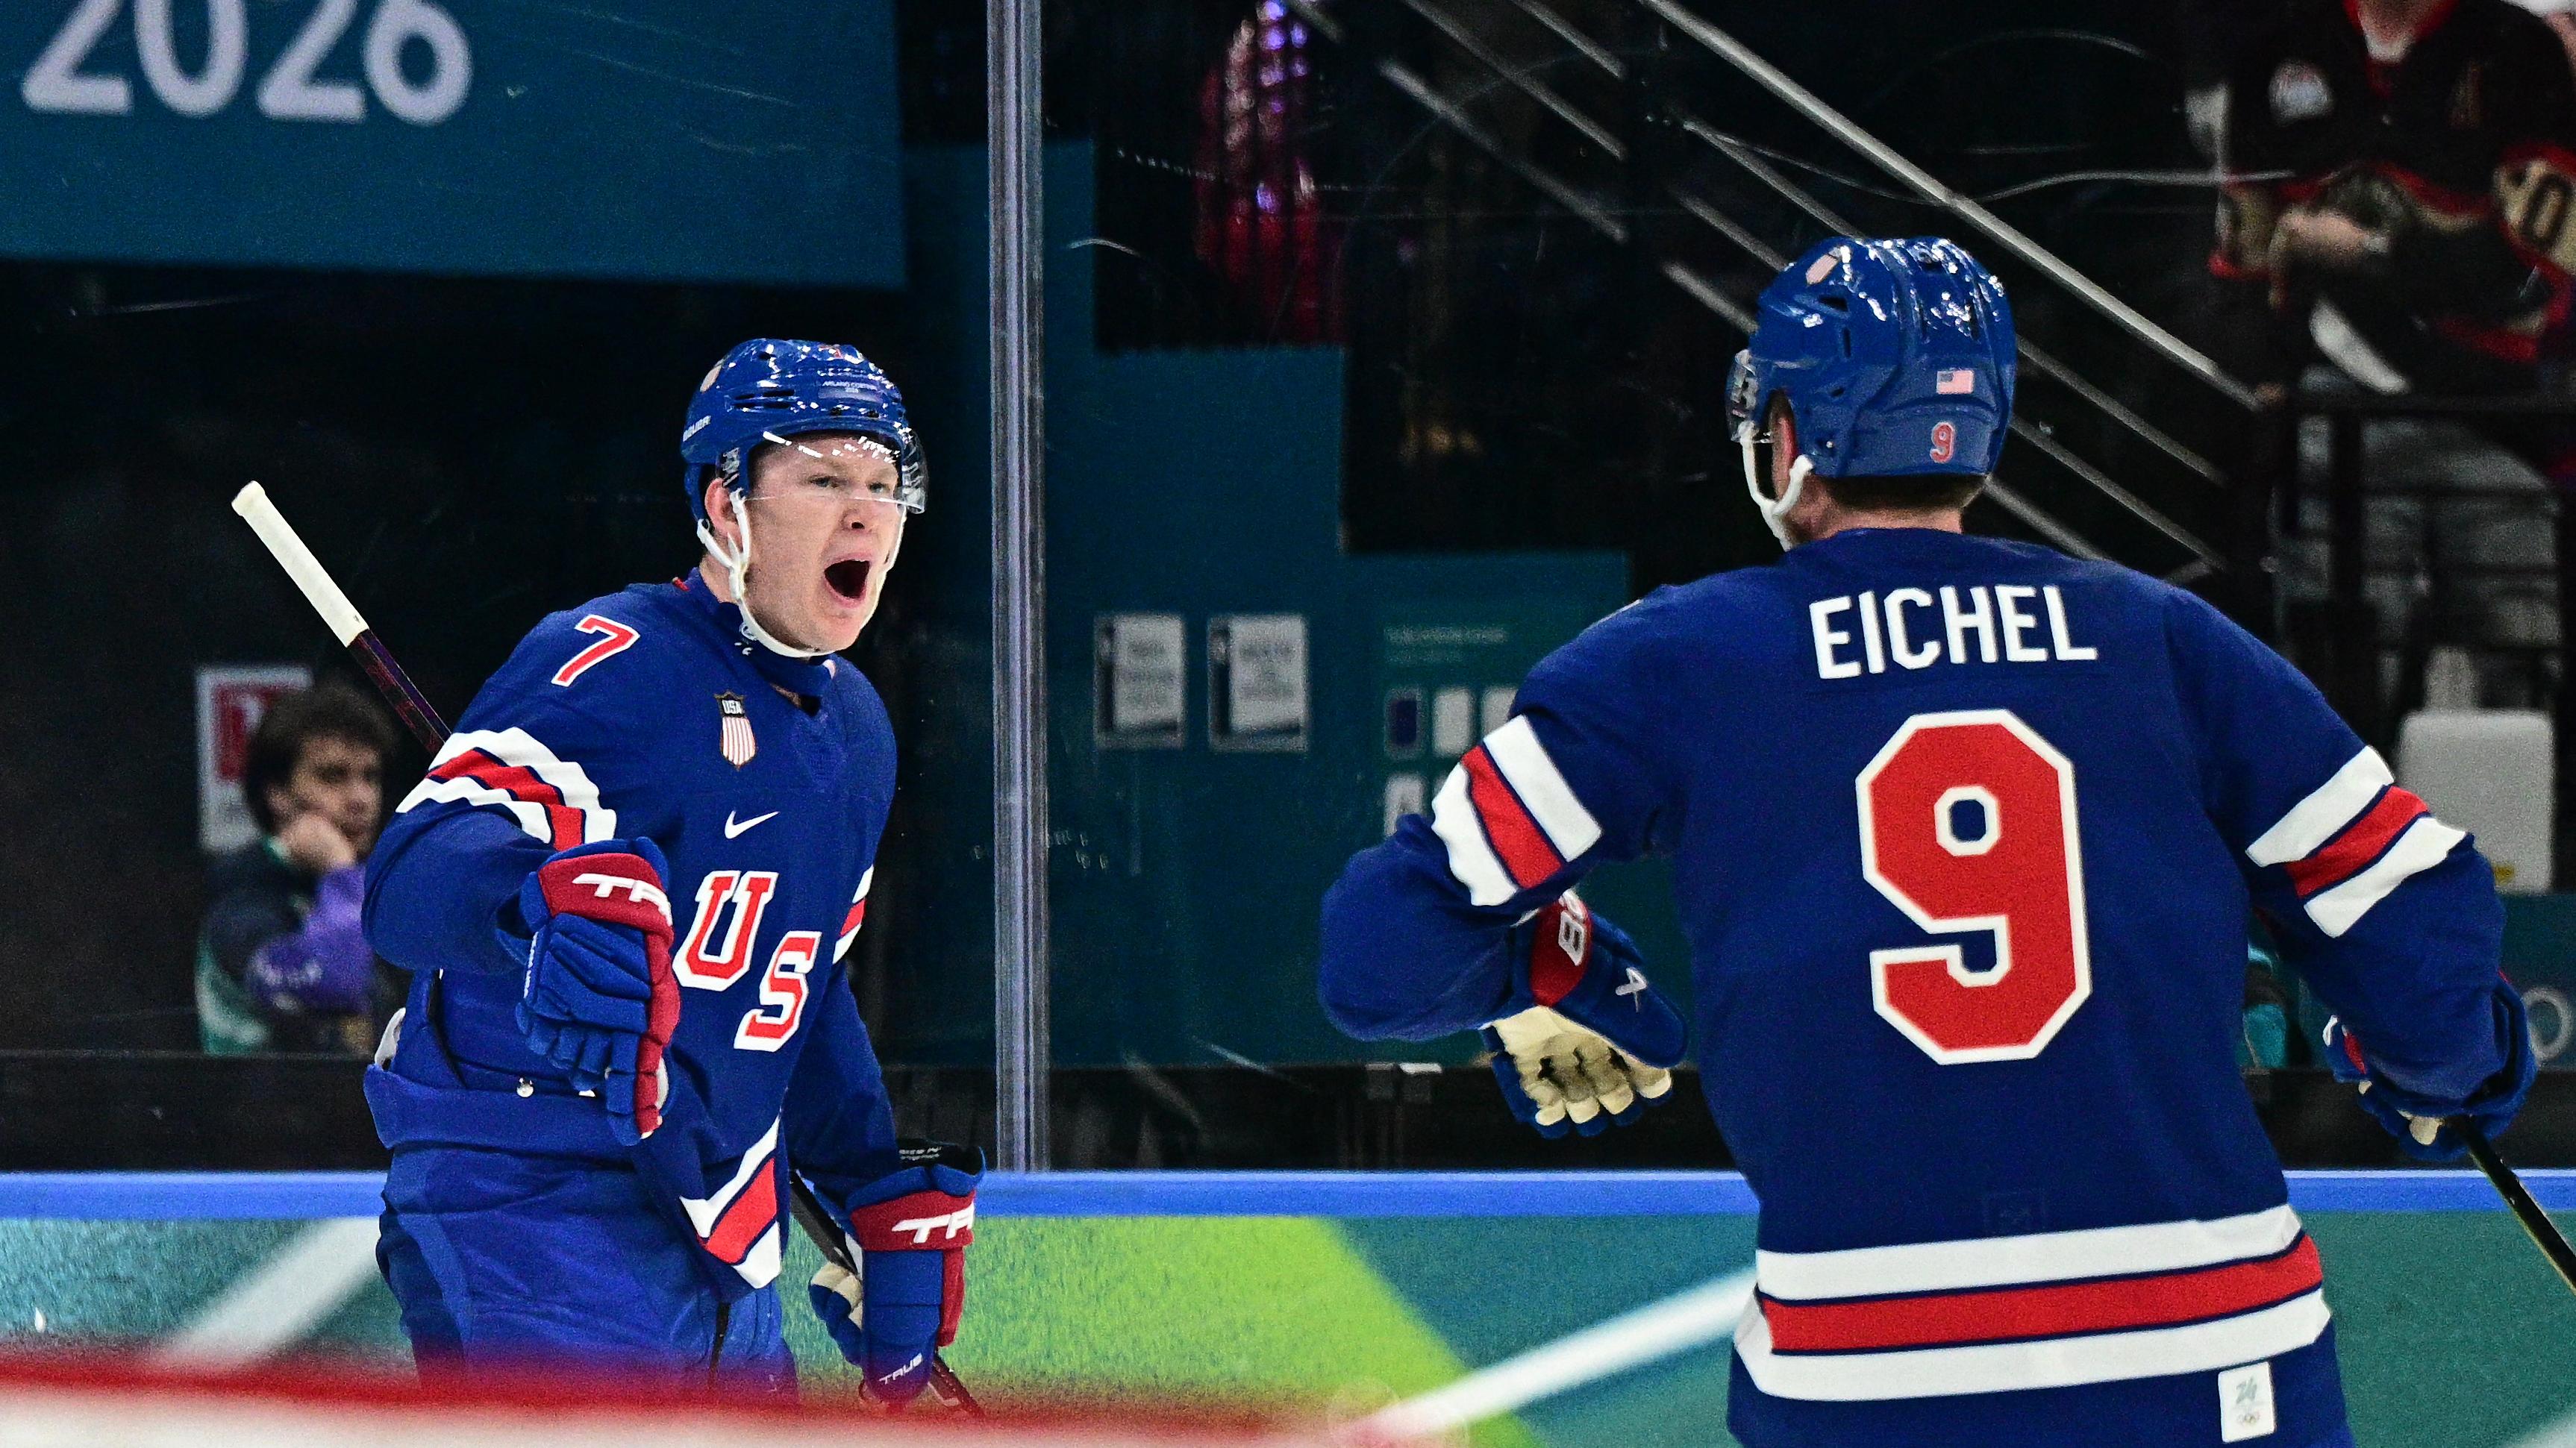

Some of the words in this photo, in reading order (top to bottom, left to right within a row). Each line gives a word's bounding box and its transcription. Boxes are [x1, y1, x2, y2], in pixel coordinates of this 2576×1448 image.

[22, 0, 475, 125] 2026
[1930, 421, 1955, 463] 9
[551, 614, 640, 687] 7
[1809, 585, 2098, 679] EICHEL
[722, 699, 744, 714] USA
[1855, 709, 2092, 1065] 9
[878, 1353, 923, 1385] TRUE
